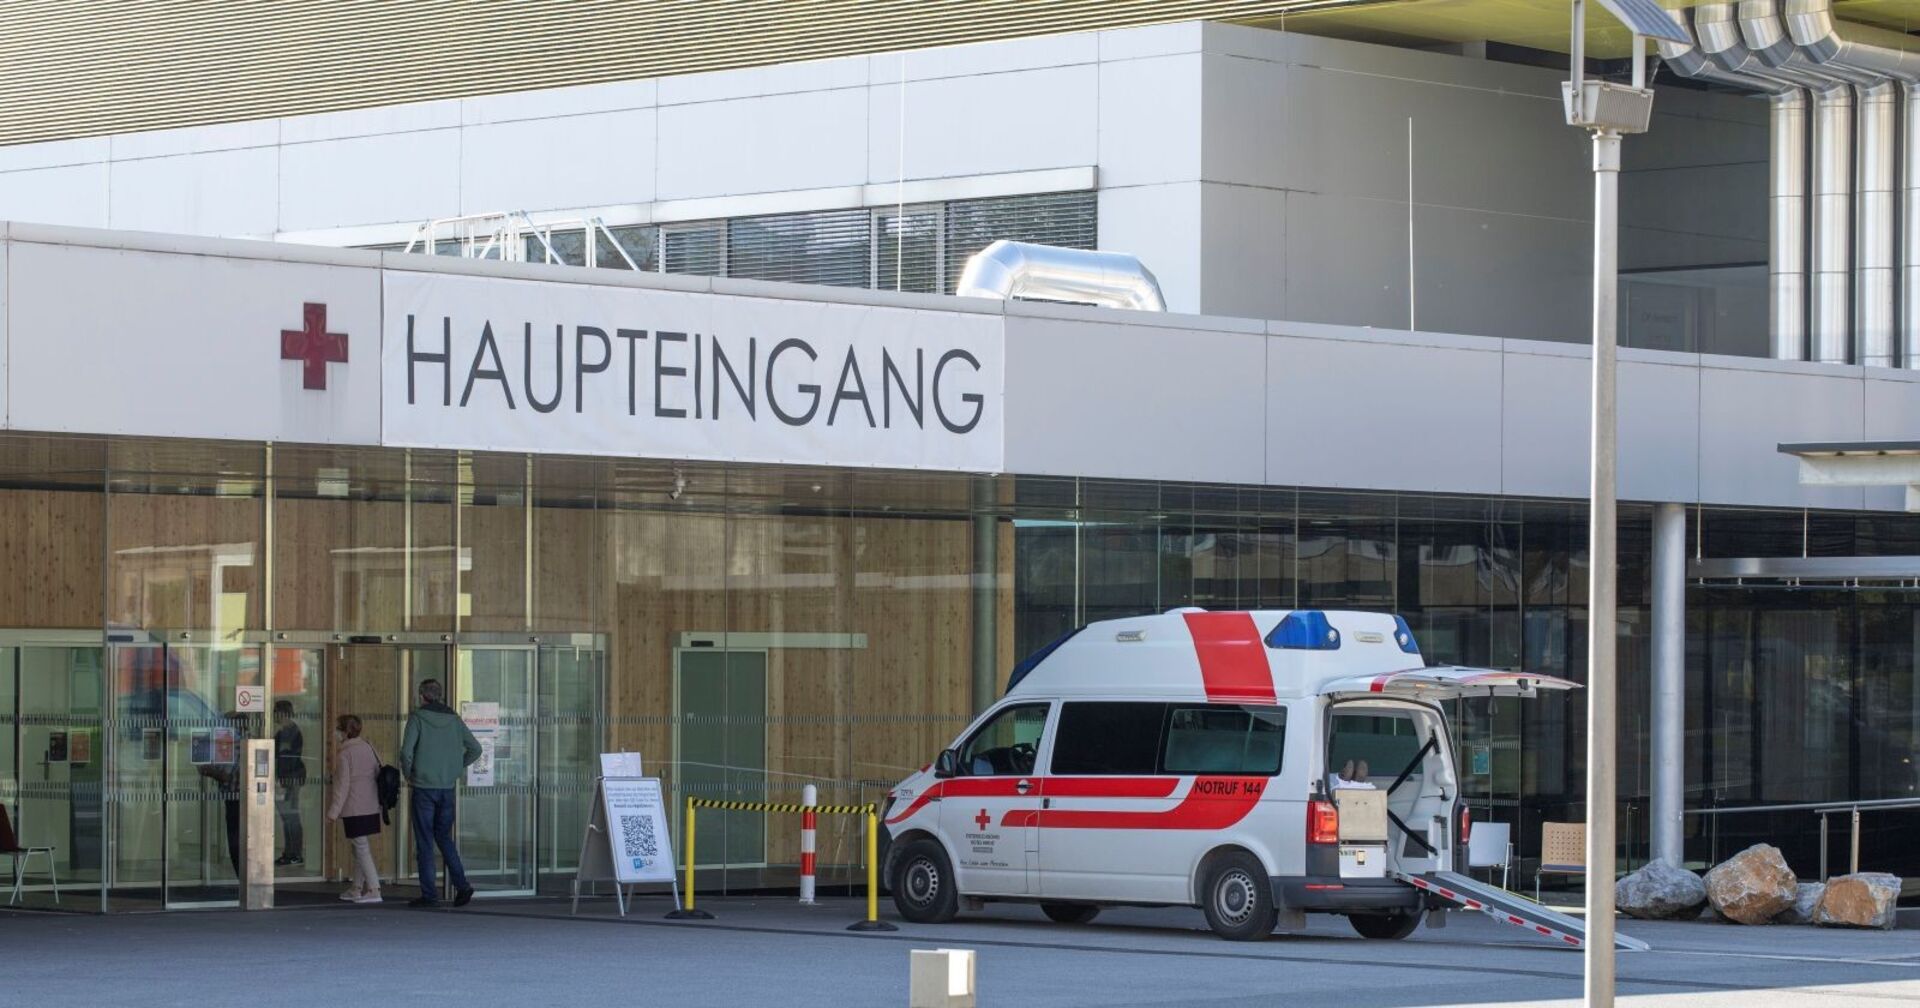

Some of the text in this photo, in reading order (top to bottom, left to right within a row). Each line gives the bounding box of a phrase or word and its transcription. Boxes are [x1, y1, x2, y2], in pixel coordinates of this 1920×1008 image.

[406, 314, 984, 434] HAUPTEINGANG
[1193, 781, 1261, 795] NOTRUF 144
